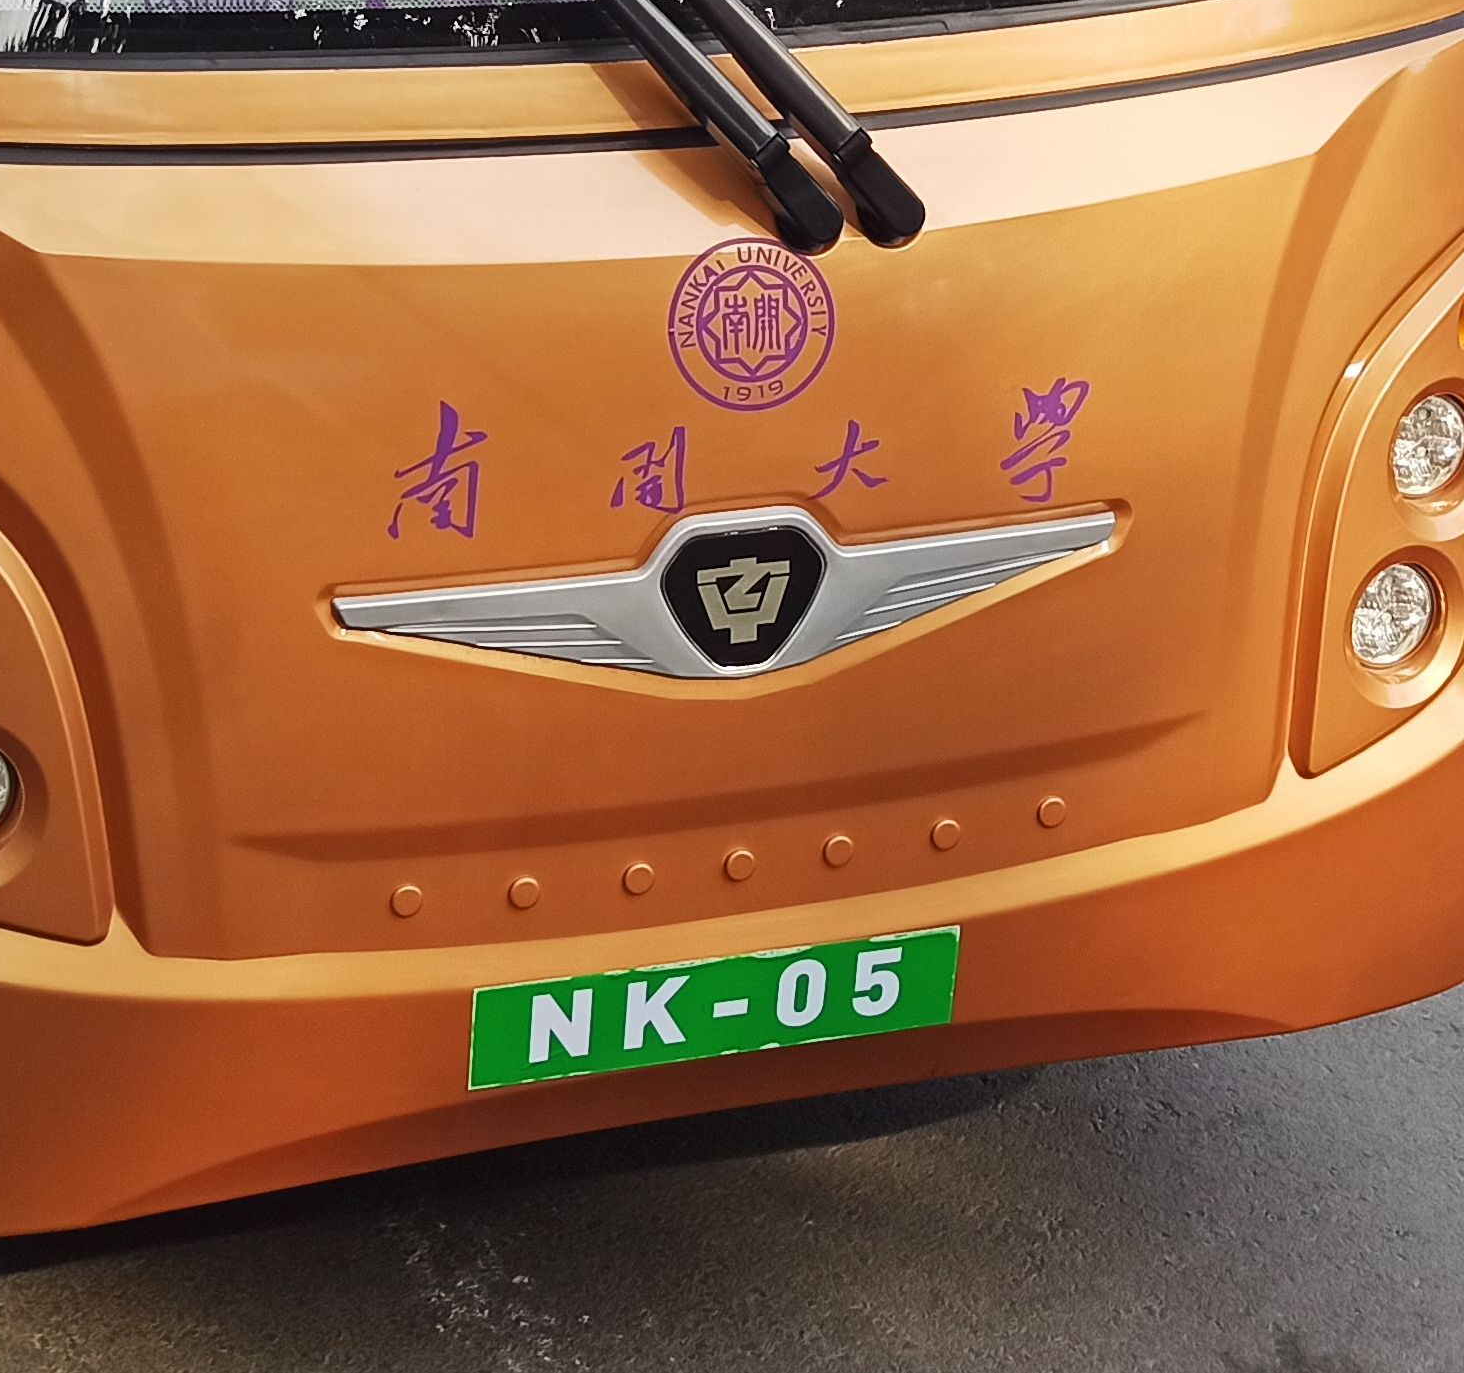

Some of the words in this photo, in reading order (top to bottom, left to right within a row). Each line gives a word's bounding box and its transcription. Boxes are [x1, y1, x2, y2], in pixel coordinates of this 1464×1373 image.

[678, 259, 726, 349] NANKAI
[722, 379, 784, 402] 1919
[528, 945, 905, 1064] NK-05
